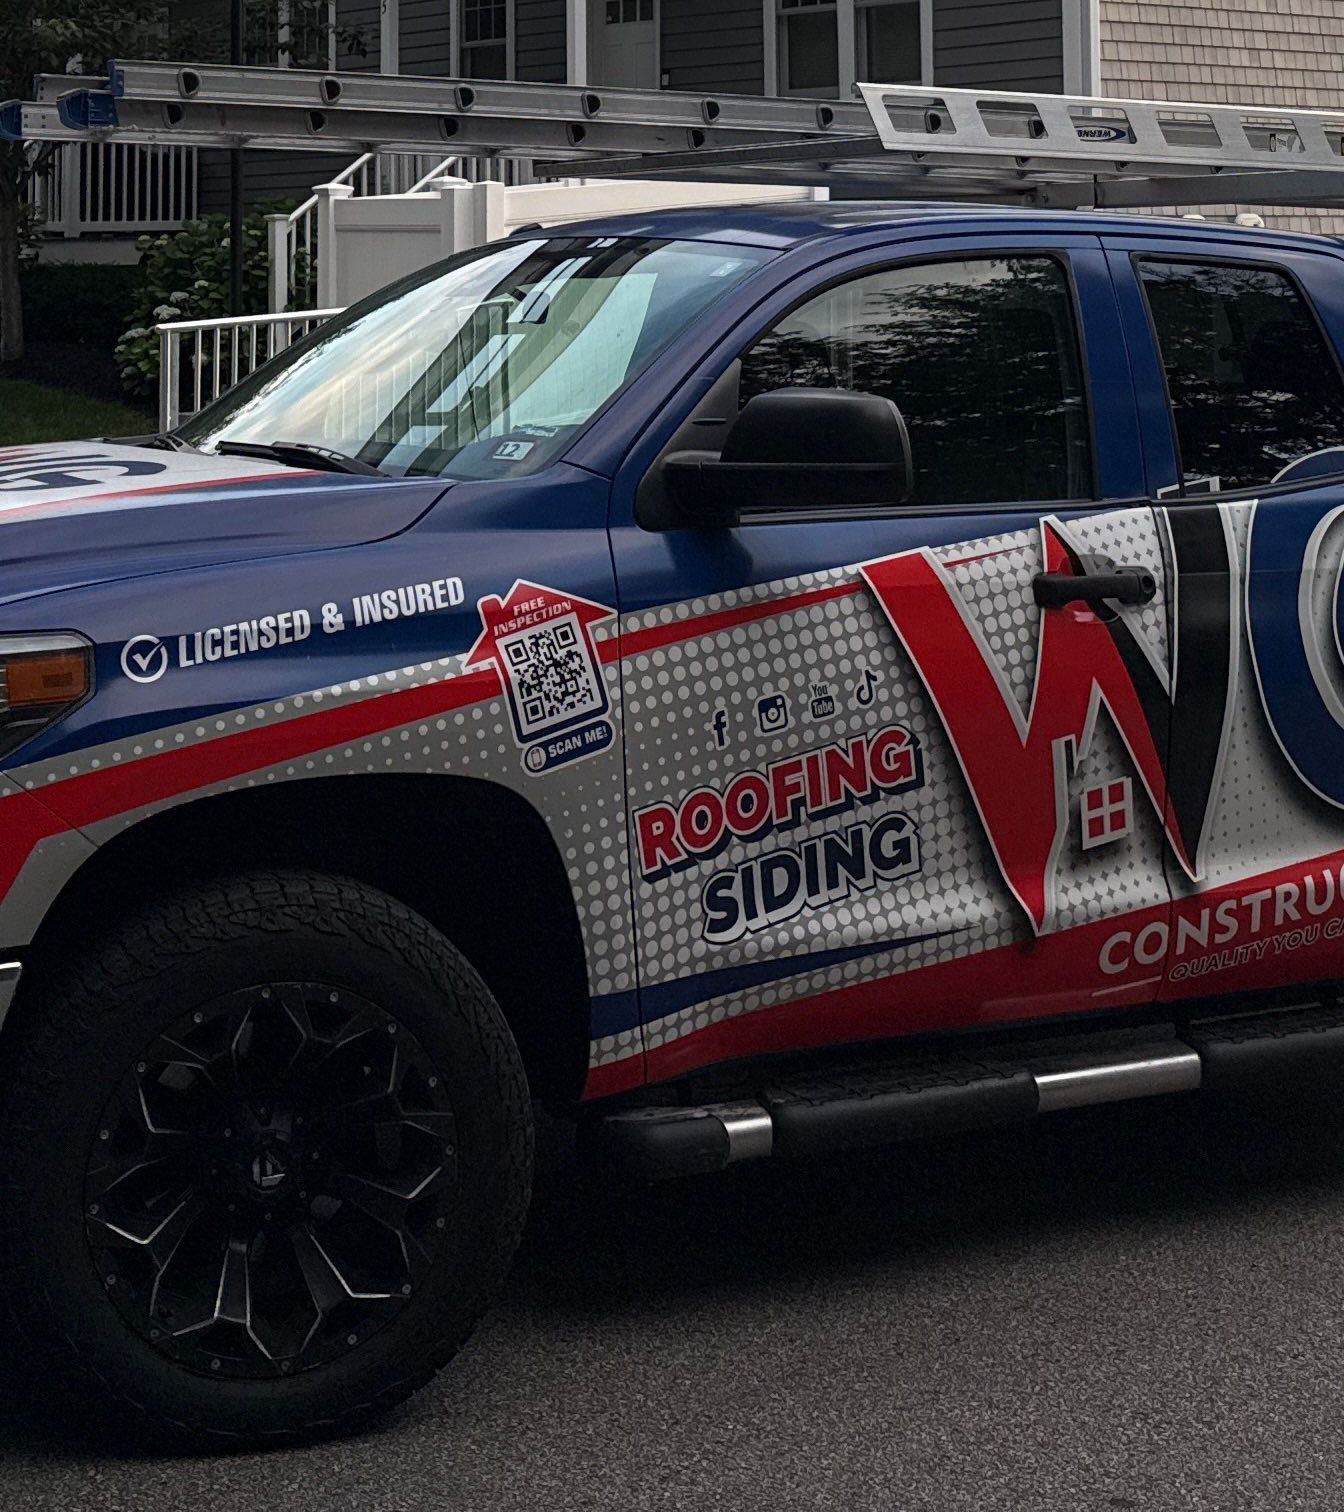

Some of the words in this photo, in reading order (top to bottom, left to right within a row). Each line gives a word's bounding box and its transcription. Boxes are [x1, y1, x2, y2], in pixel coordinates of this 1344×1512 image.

[178, 609, 311, 668] LICENSED
[321, 602, 345, 634] &
[352, 576, 465, 627] INSURED
[493, 600, 572, 637] INSPECTION
[513, 596, 546, 617] FREE
[548, 734, 583, 758] SCAN
[585, 725, 608, 744] ME!
[633, 724, 923, 882] ROOFING
[702, 811, 922, 945] SIDING
[1169, 936, 1269, 982] QUALITY
[1270, 924, 1320, 954] YOU
